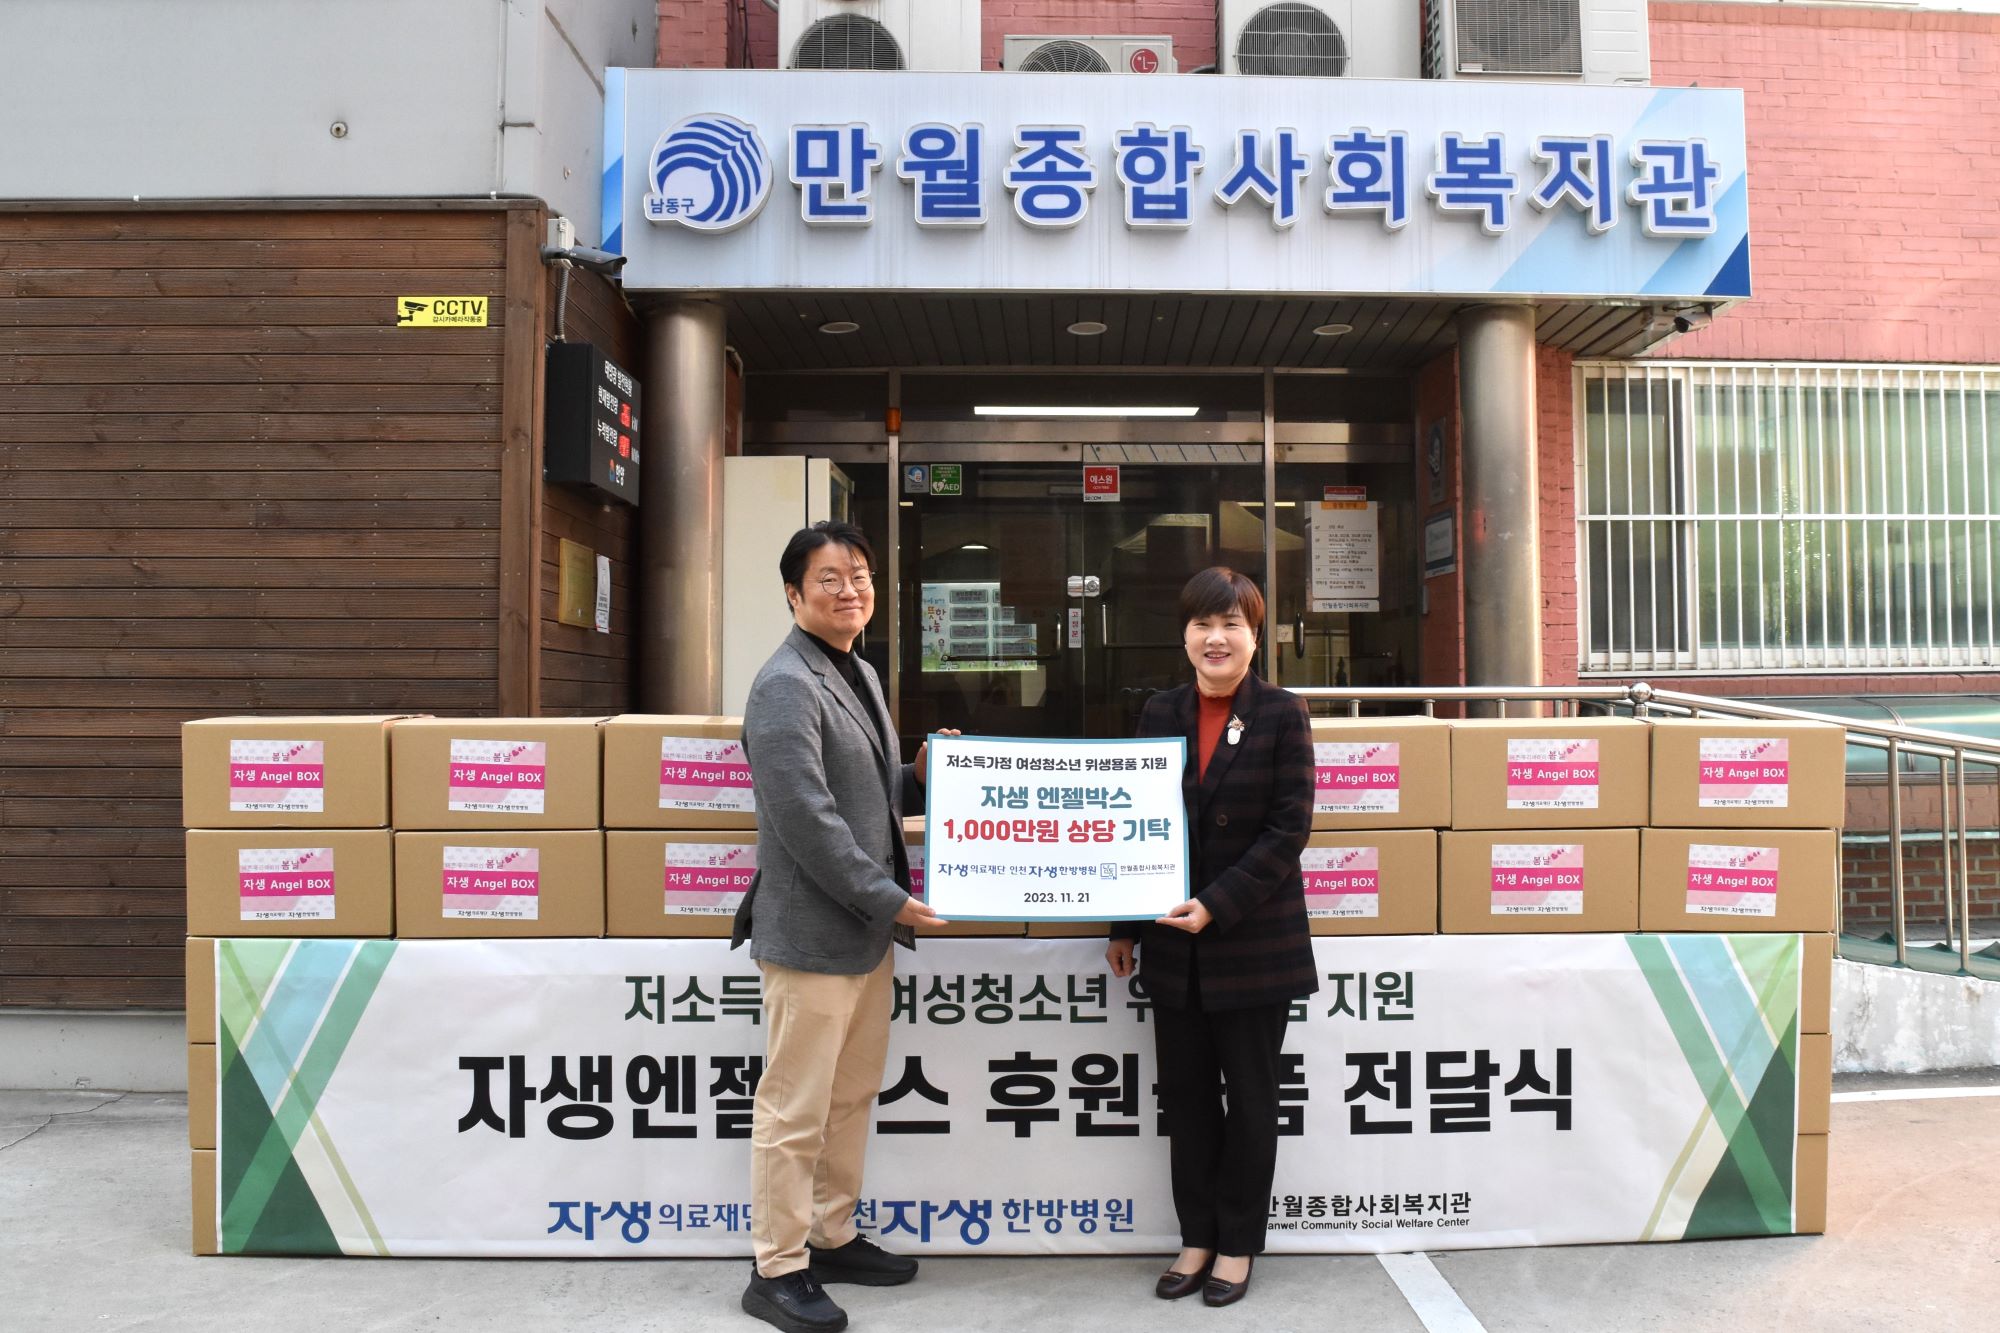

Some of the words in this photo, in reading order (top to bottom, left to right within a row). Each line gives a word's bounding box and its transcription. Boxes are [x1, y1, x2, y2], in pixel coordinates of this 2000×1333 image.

[794, 128, 1719, 228] 만월종합사회복지관
[651, 198, 694, 214] 남동구
[433, 300, 483, 315] CCTV
[597, 418, 617, 447] 누적발전량
[943, 483, 960, 491] AED
[1089, 475, 1112, 485] 에스원
[1071, 611, 1079, 638] 고정문
[947, 755, 1011, 769] 저소득가정
[1016, 757, 1081, 771] 여성청소년
[1085, 758, 1137, 771] 위생용품
[1141, 757, 1167, 769] 지원
[234, 769, 256, 781] 자생
[260, 771, 292, 783] Angel
[297, 772, 320, 781] BOX
[453, 768, 476, 781] 자생
[480, 771, 513, 783] Angel
[518, 772, 541, 783] BOX
[665, 766, 687, 779] 자생
[692, 769, 725, 782] Angel
[729, 771, 753, 782] BOX
[1336, 773, 1368, 785] Angel
[1373, 774, 1395, 782] BOX
[1512, 768, 1532, 780] 자생
[1537, 769, 1569, 781] Angel
[1573, 770, 1595, 779] BOX
[1703, 767, 1724, 779] 자생
[1728, 769, 1759, 779] Angel
[1763, 769, 1785, 777] BOX
[981, 785, 1028, 809] 자생
[1036, 787, 1132, 809] 엔젤박스
[944, 818, 1059, 842] 1,000만원
[1067, 819, 1115, 842] 상당
[1123, 818, 1171, 841] 기탁
[938, 863, 1006, 877] 자생의료재단
[1120, 864, 1175, 872] 만월종합사회복지관
[243, 879, 265, 890] 자생
[270, 879, 302, 891] Angel
[307, 880, 330, 889] BOX
[447, 876, 469, 889] 자생
[473, 877, 506, 890] Angel
[511, 879, 535, 889] BOX
[669, 872, 691, 885] 자생
[696, 874, 729, 887] Angel
[1315, 878, 1346, 890] Angel
[1352, 878, 1375, 886] BOX
[1495, 874, 1517, 885] 자생
[1521, 875, 1553, 887] Angel
[1557, 875, 1580, 884] BOX
[1691, 873, 1712, 885] 자생
[1716, 876, 1747, 887] Angel
[1751, 877, 1774, 887] BOX
[1024, 893, 1057, 902] 2023.
[1060, 893, 1074, 902] 11.
[1077, 893, 1090, 902] 21
[625, 975, 763, 1025] 저소득
[891, 973, 1107, 1025] 여성청소년
[1328, 971, 1414, 1021] 지원
[458, 1054, 950, 1140] 자생엔젤스
[1344, 1048, 1572, 1135] 전달식
[1267, 1222, 1298, 1230] anwel
[1301, 1220, 1358, 1231] Community
[1362, 1219, 1392, 1228] Social
[1396, 1219, 1433, 1228] Welfare
[1437, 1218, 1469, 1227] Center
